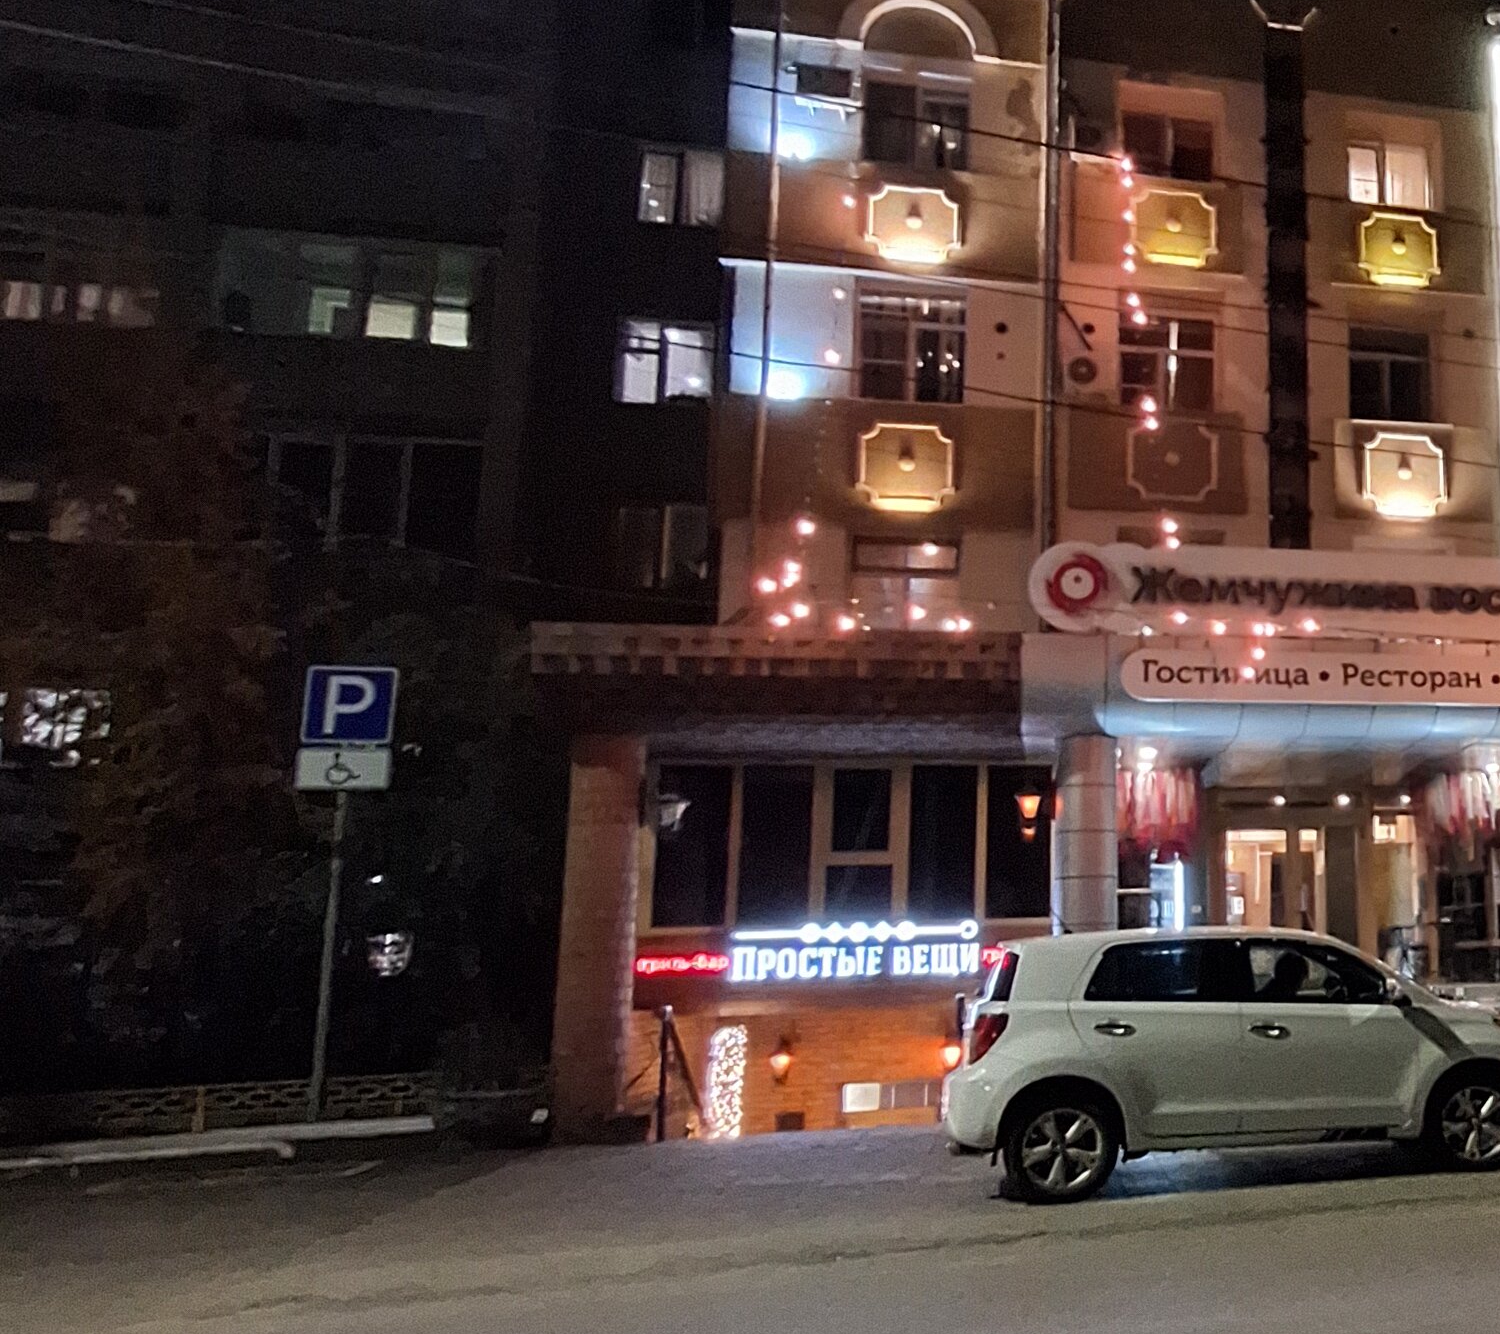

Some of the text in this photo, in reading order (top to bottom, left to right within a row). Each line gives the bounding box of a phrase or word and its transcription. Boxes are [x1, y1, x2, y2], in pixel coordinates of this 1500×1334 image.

[1341, 662, 1482, 693] Ресторан
[322, 674, 376, 735] P
[731, 945, 884, 982] ПРОСТЫЕ
[893, 942, 980, 977] ВЕЩИ
